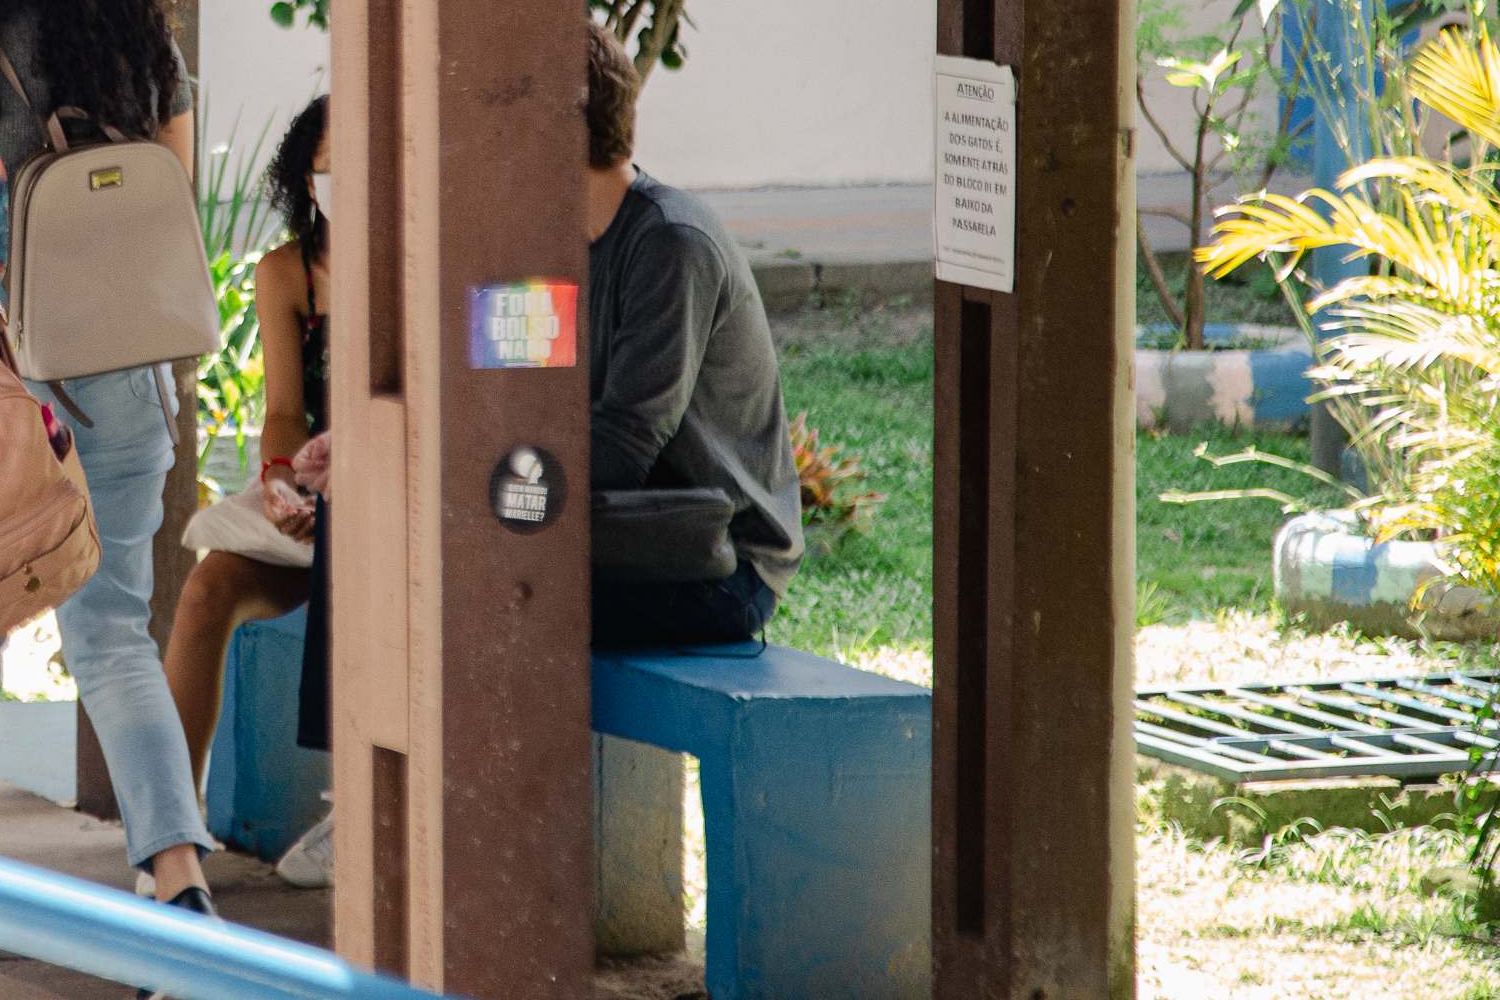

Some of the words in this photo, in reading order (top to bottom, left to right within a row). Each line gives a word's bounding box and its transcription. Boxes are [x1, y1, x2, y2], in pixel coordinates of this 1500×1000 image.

[957, 83, 995, 100] ATENÇÃO
[945, 111, 950, 121] A
[952, 112, 1009, 133] ALIMENTAÇÃO
[949, 133, 966, 147] DOS
[968, 136, 993, 151] GATOS
[944, 152, 980, 170] SOMENTE
[982, 158, 1008, 175] ATRÁS
[944, 173, 955, 186] DO
[956, 176, 983, 192] BLOCO
[984, 181, 992, 194] III
[994, 183, 1007, 196] EM
[955, 197, 980, 213] BAIXO
[981, 202, 994, 215] DA
[952, 218, 997, 238] PASSARELA
[496, 292, 553, 316] FORA
[491, 316, 560, 341] BOLSO
[498, 340, 552, 360] NARO
[505, 492, 547, 511] MATAR
[504, 508, 545, 522] MARIELLE?
